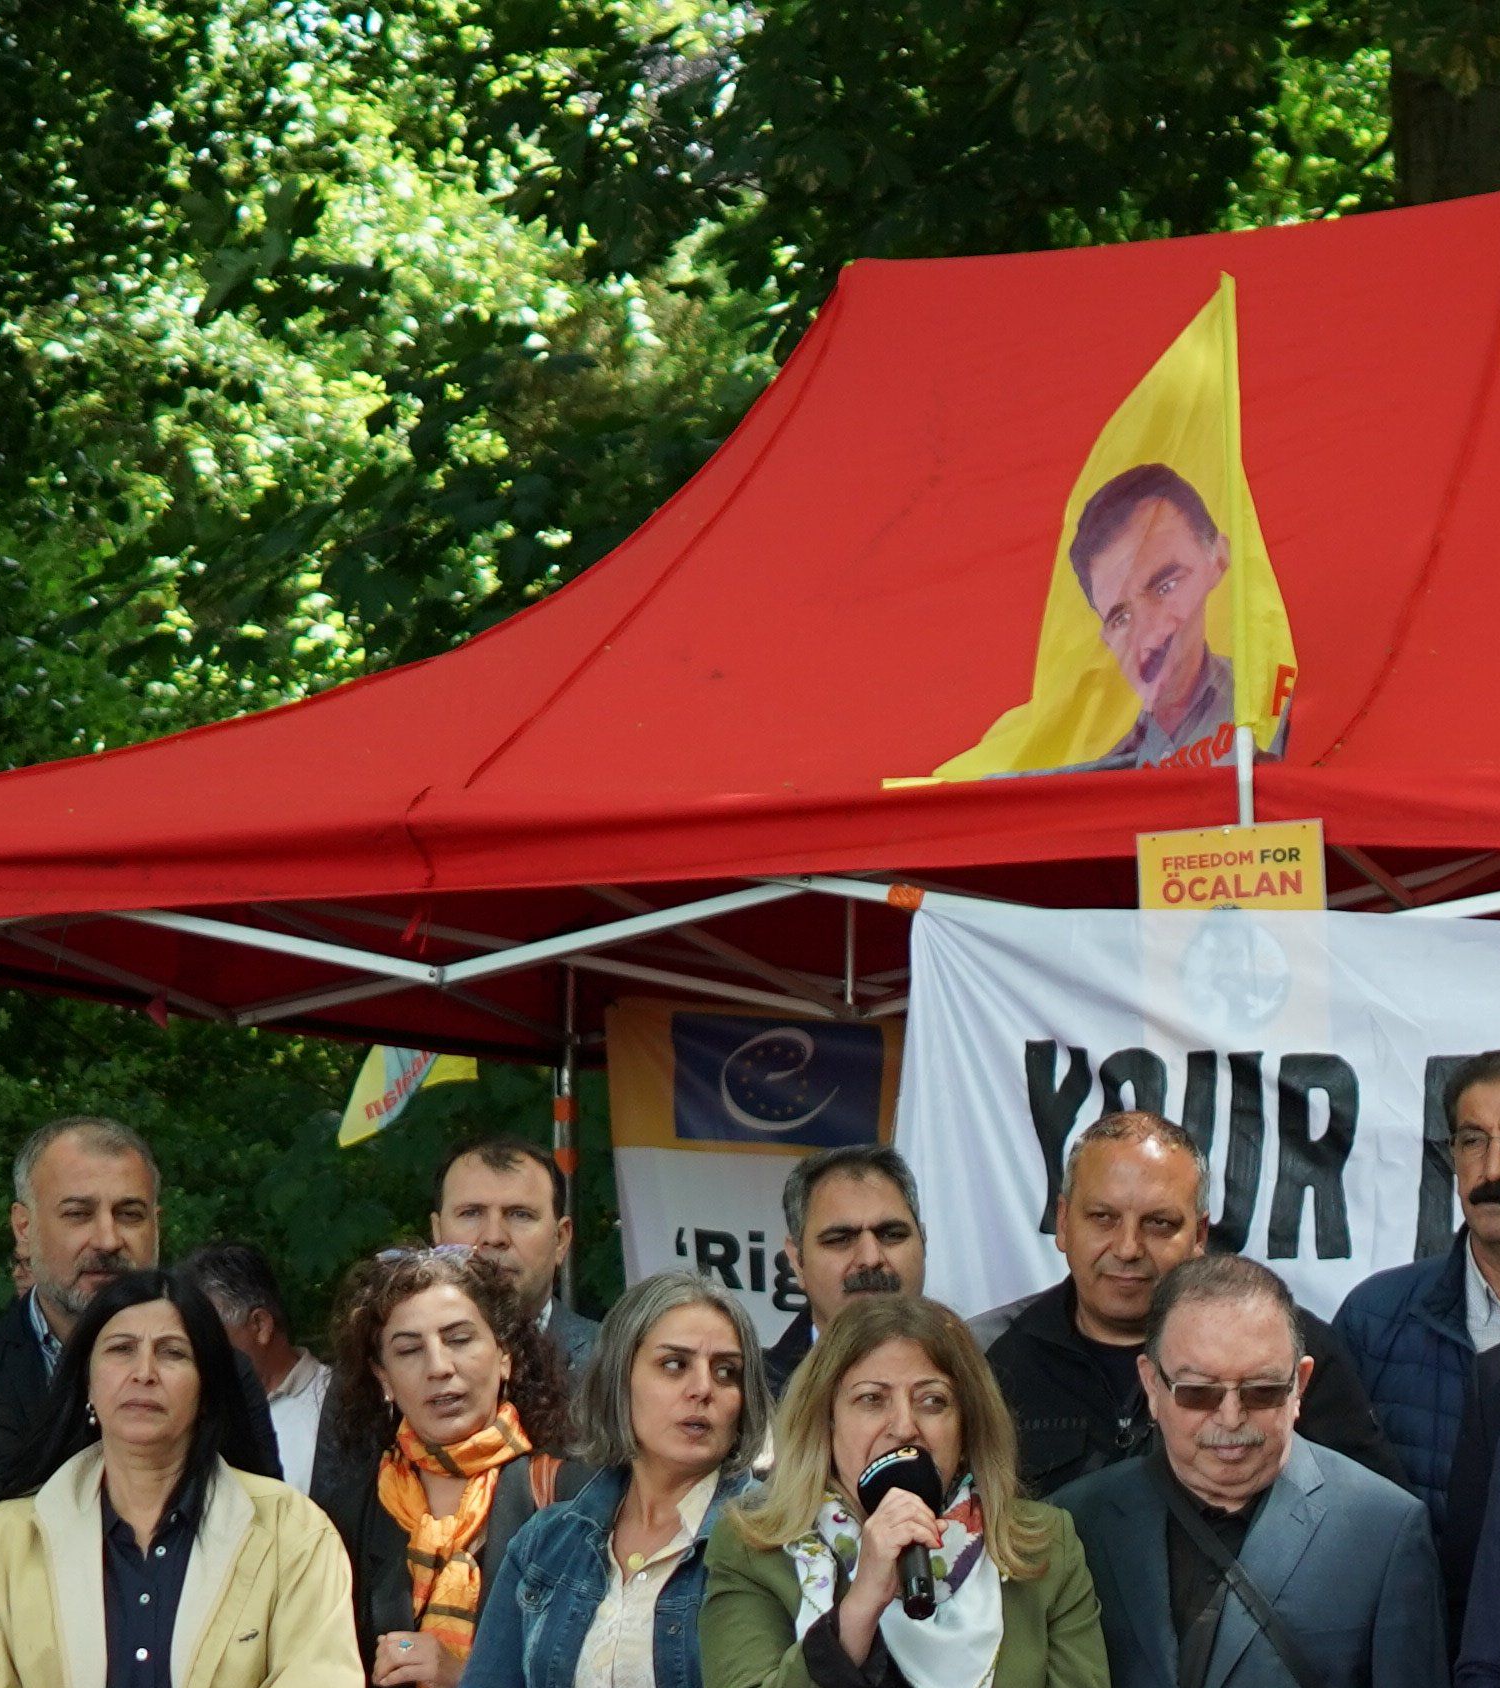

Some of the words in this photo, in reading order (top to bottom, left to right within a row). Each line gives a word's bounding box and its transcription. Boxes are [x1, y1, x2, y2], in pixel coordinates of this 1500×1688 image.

[1162, 850, 1254, 872] FREEDOM
[1260, 847, 1301, 864] FOR
[1162, 869, 1303, 904] ÖCALAN
